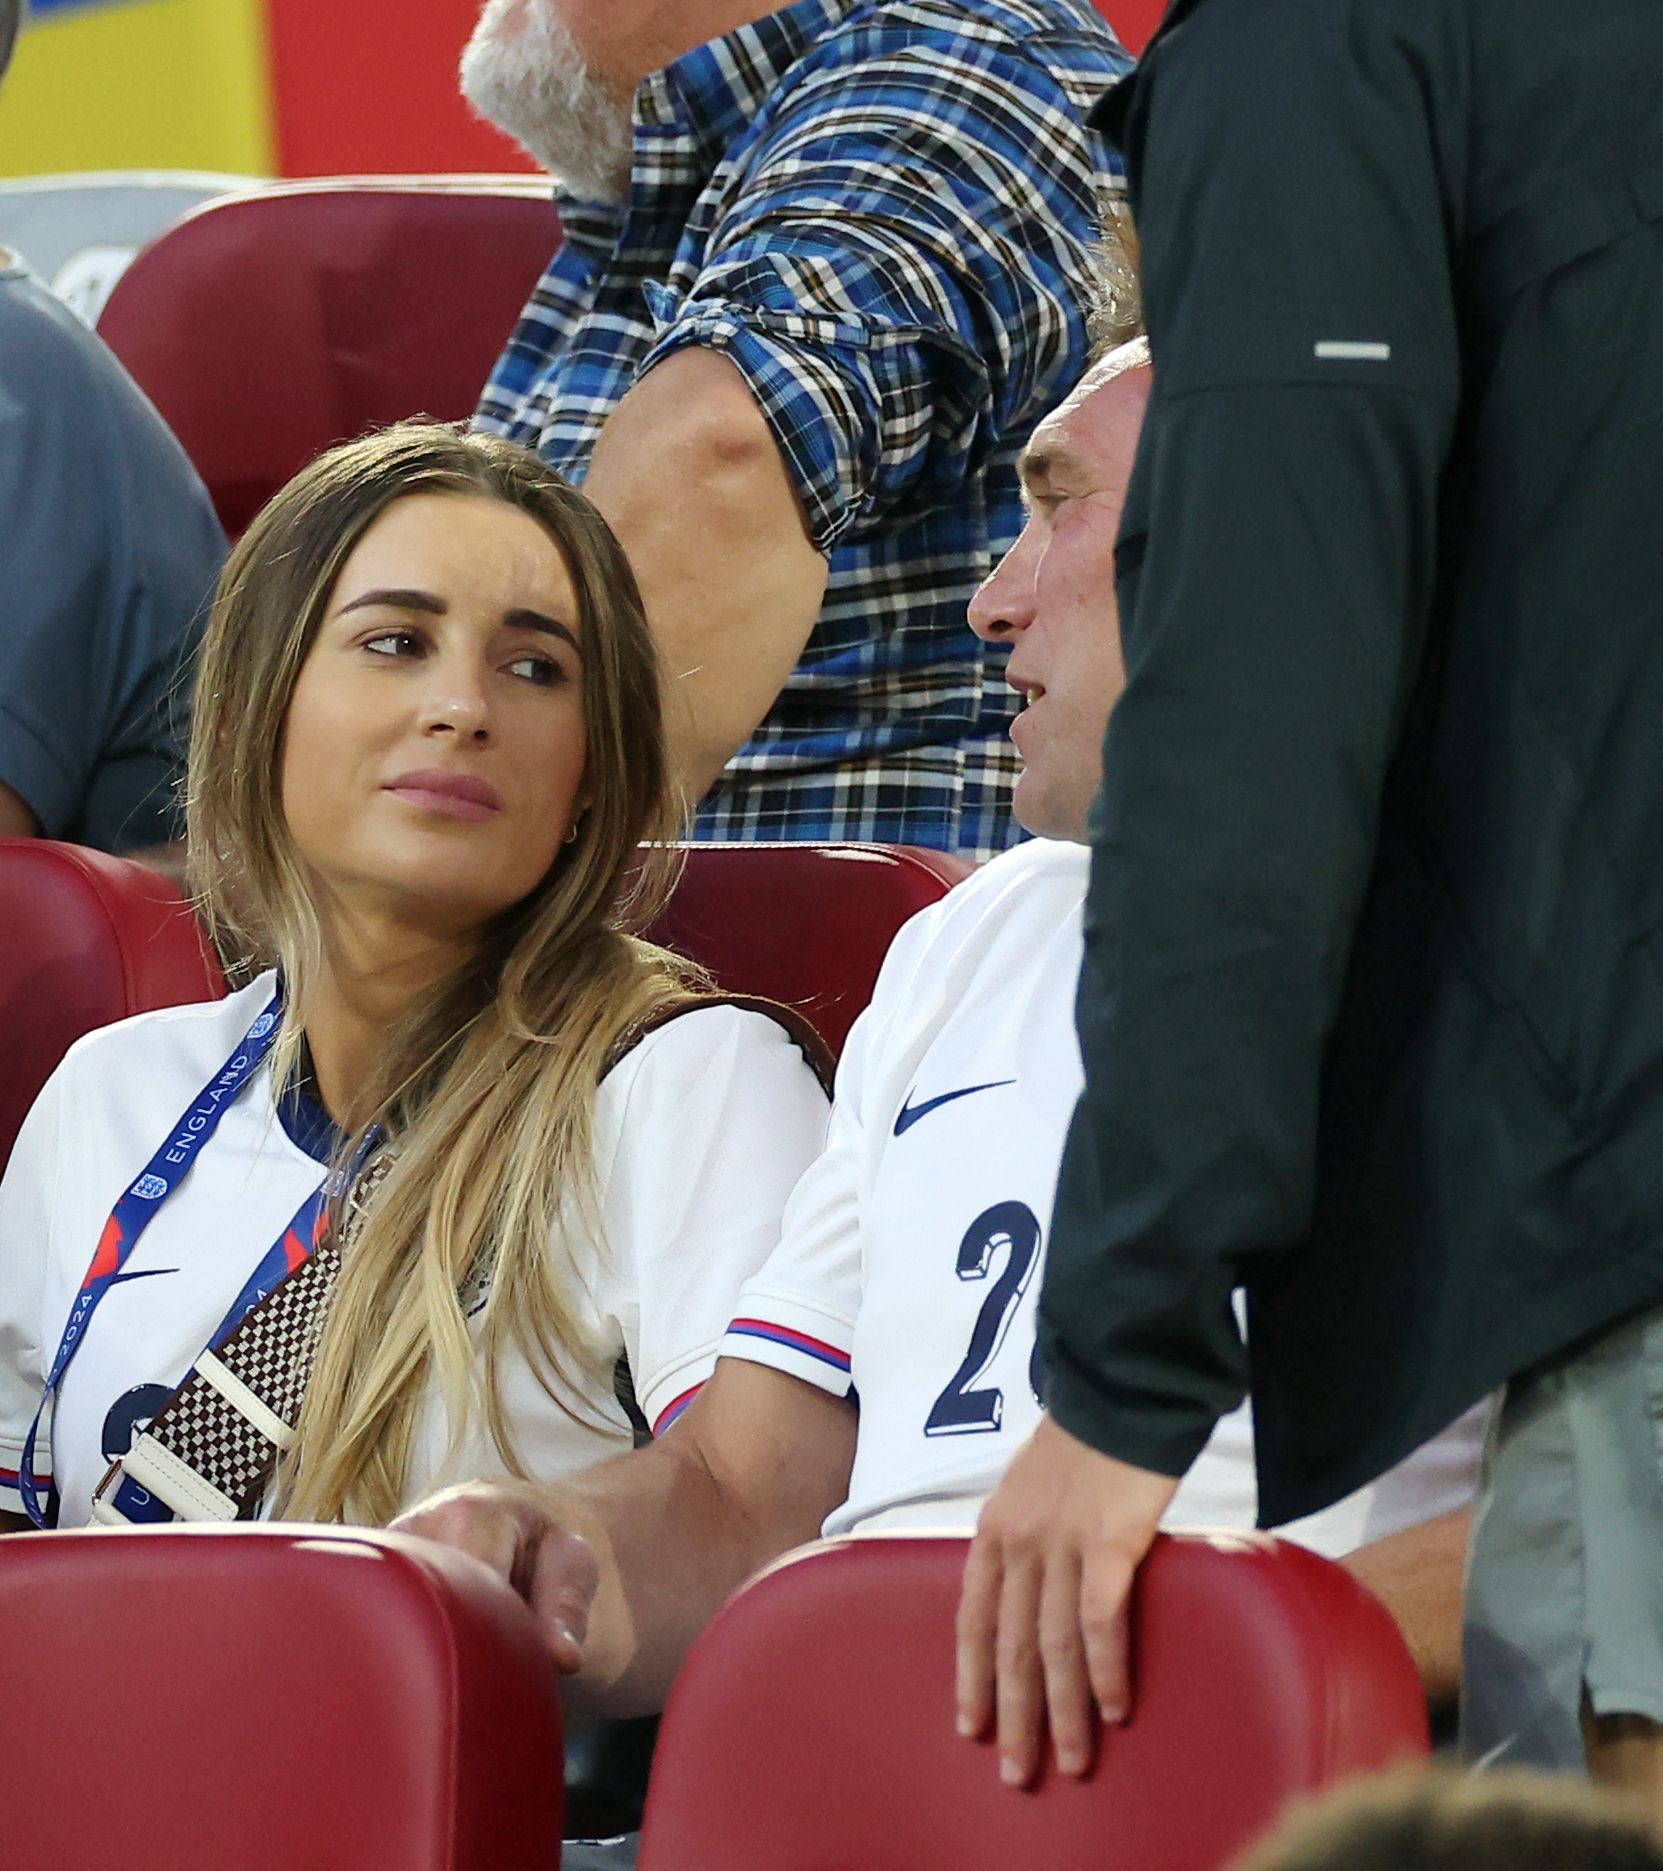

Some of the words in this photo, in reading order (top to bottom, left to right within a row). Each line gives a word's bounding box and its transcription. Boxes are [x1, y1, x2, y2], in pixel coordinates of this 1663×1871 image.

[165, 1054, 248, 1164] ENGLAND
[59, 1294, 93, 1356] 2024
[924, 1199, 1047, 1438] 2
